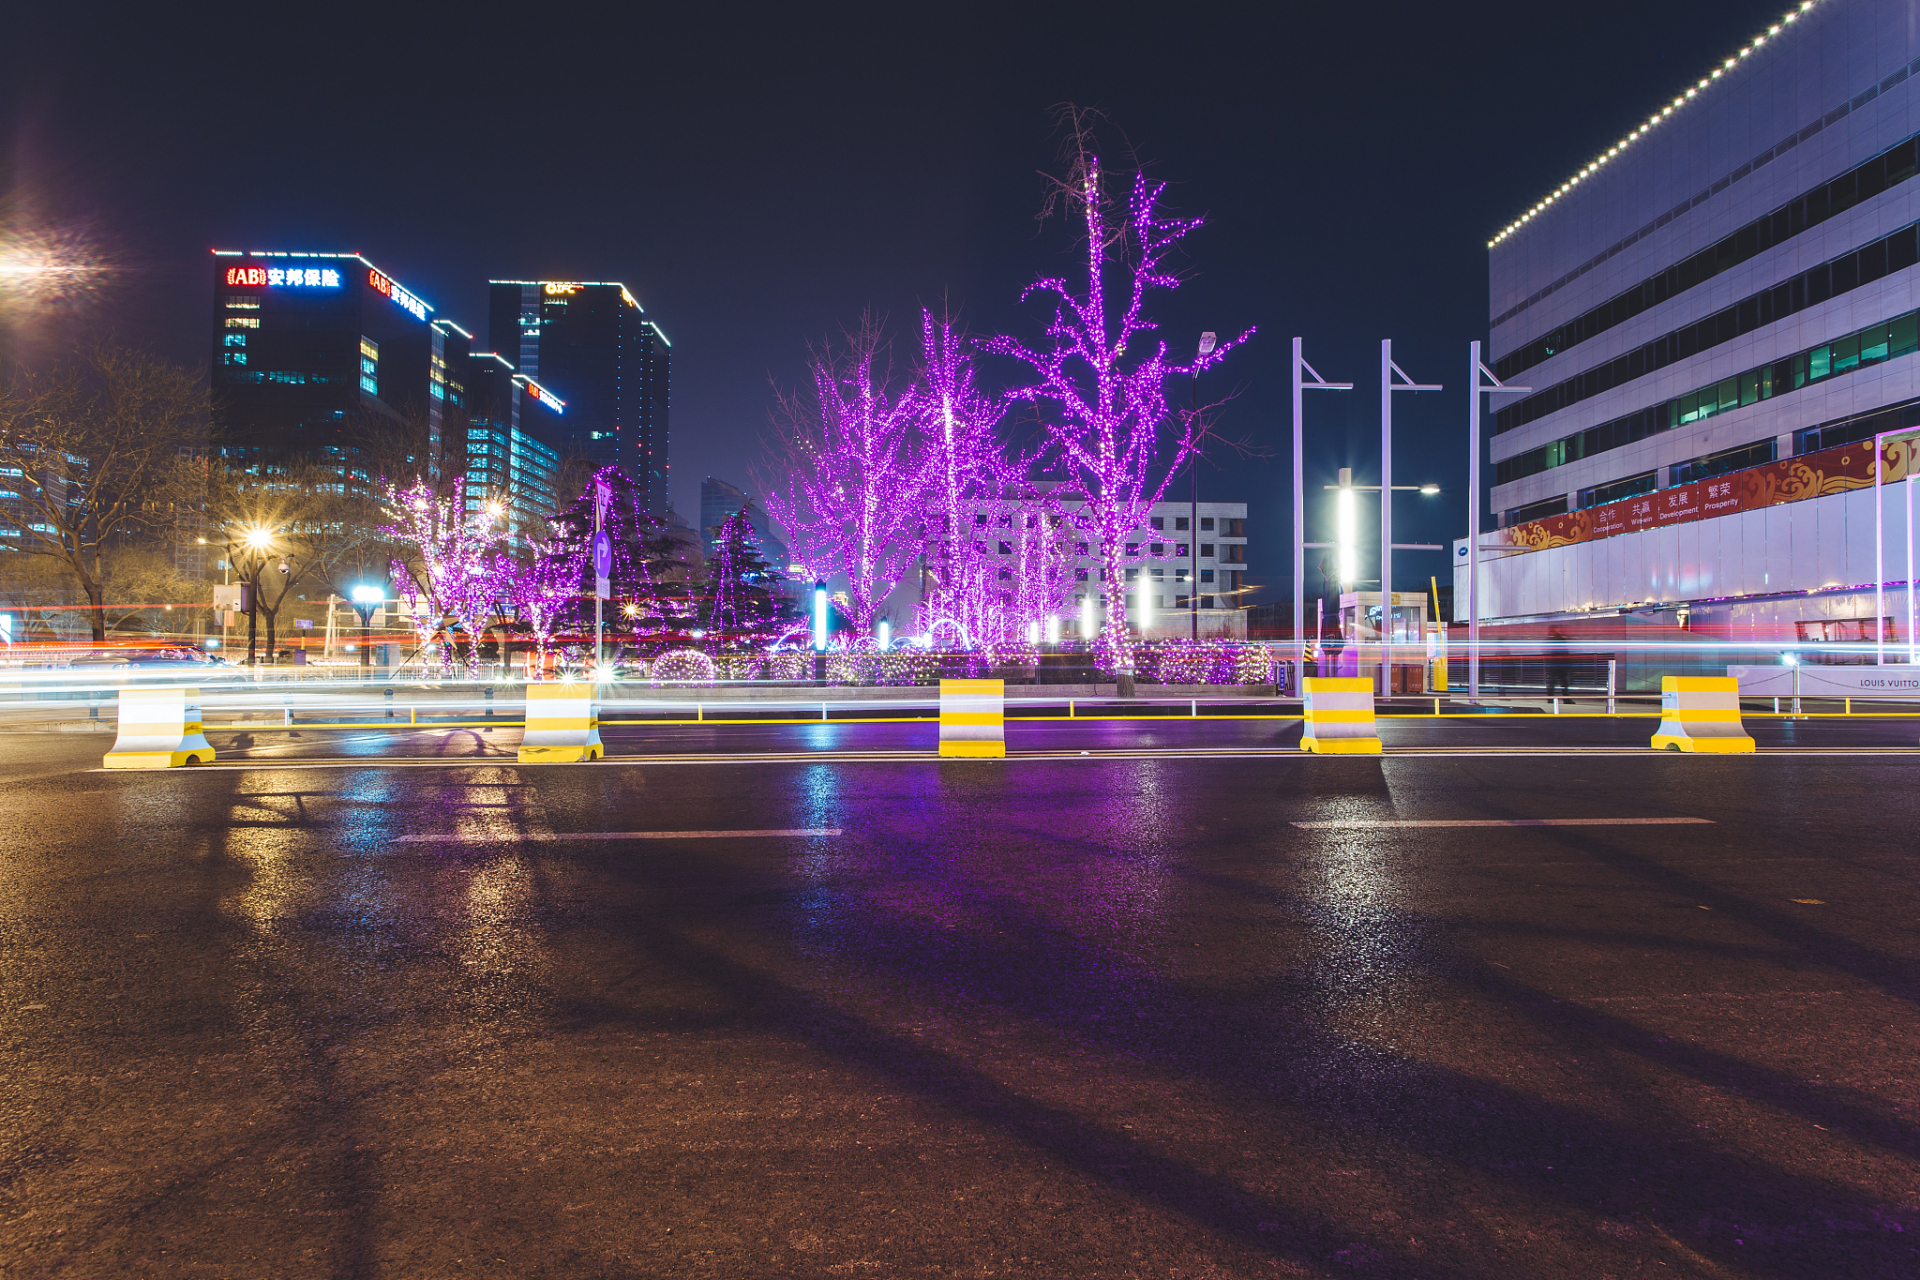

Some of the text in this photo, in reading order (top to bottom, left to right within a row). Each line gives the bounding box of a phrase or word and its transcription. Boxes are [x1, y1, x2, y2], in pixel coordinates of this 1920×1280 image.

[267, 267, 340, 286] 安邦保险
[1708, 482, 1732, 499] 繁荣
[1668, 491, 1688, 508] 发展
[1704, 498, 1738, 511] Prosperity
[1599, 508, 1616, 523] 合作
[1632, 500, 1651, 516] 共赢
[1660, 506, 1699, 520] Development
[1593, 522, 1623, 534] Cooperation
[1860, 679, 1885, 687] LOUIS
